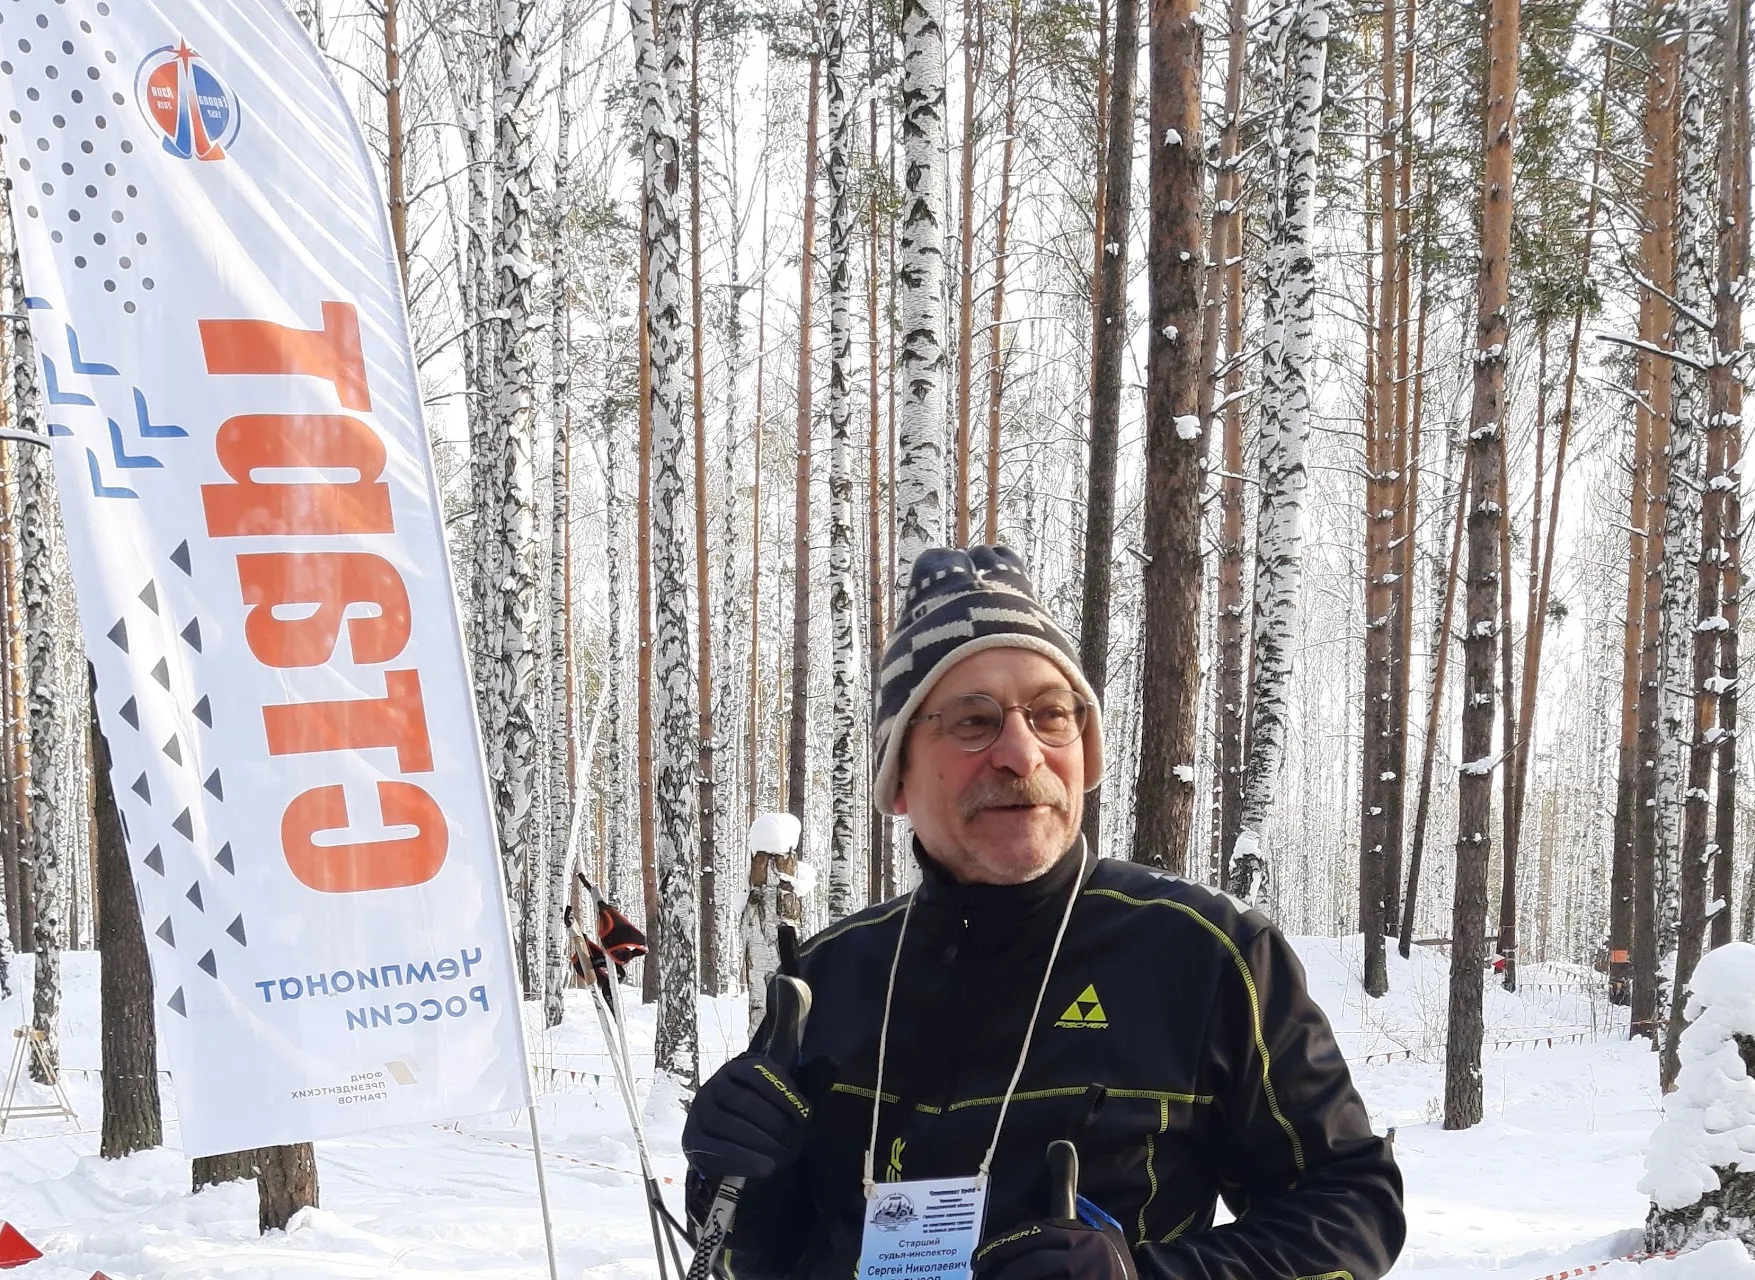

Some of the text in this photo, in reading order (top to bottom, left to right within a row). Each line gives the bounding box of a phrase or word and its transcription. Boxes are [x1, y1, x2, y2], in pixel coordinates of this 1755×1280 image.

[1053, 1021, 1109, 1029] FISCHER
[753, 1065, 804, 1110] FISCHER
[899, 1238, 941, 1249] Старший
[977, 1230, 1030, 1261] FISCHER
[878, 1248, 958, 1261] судья-инспектор
[867, 1261, 967, 1278] Сергей Николаевич
